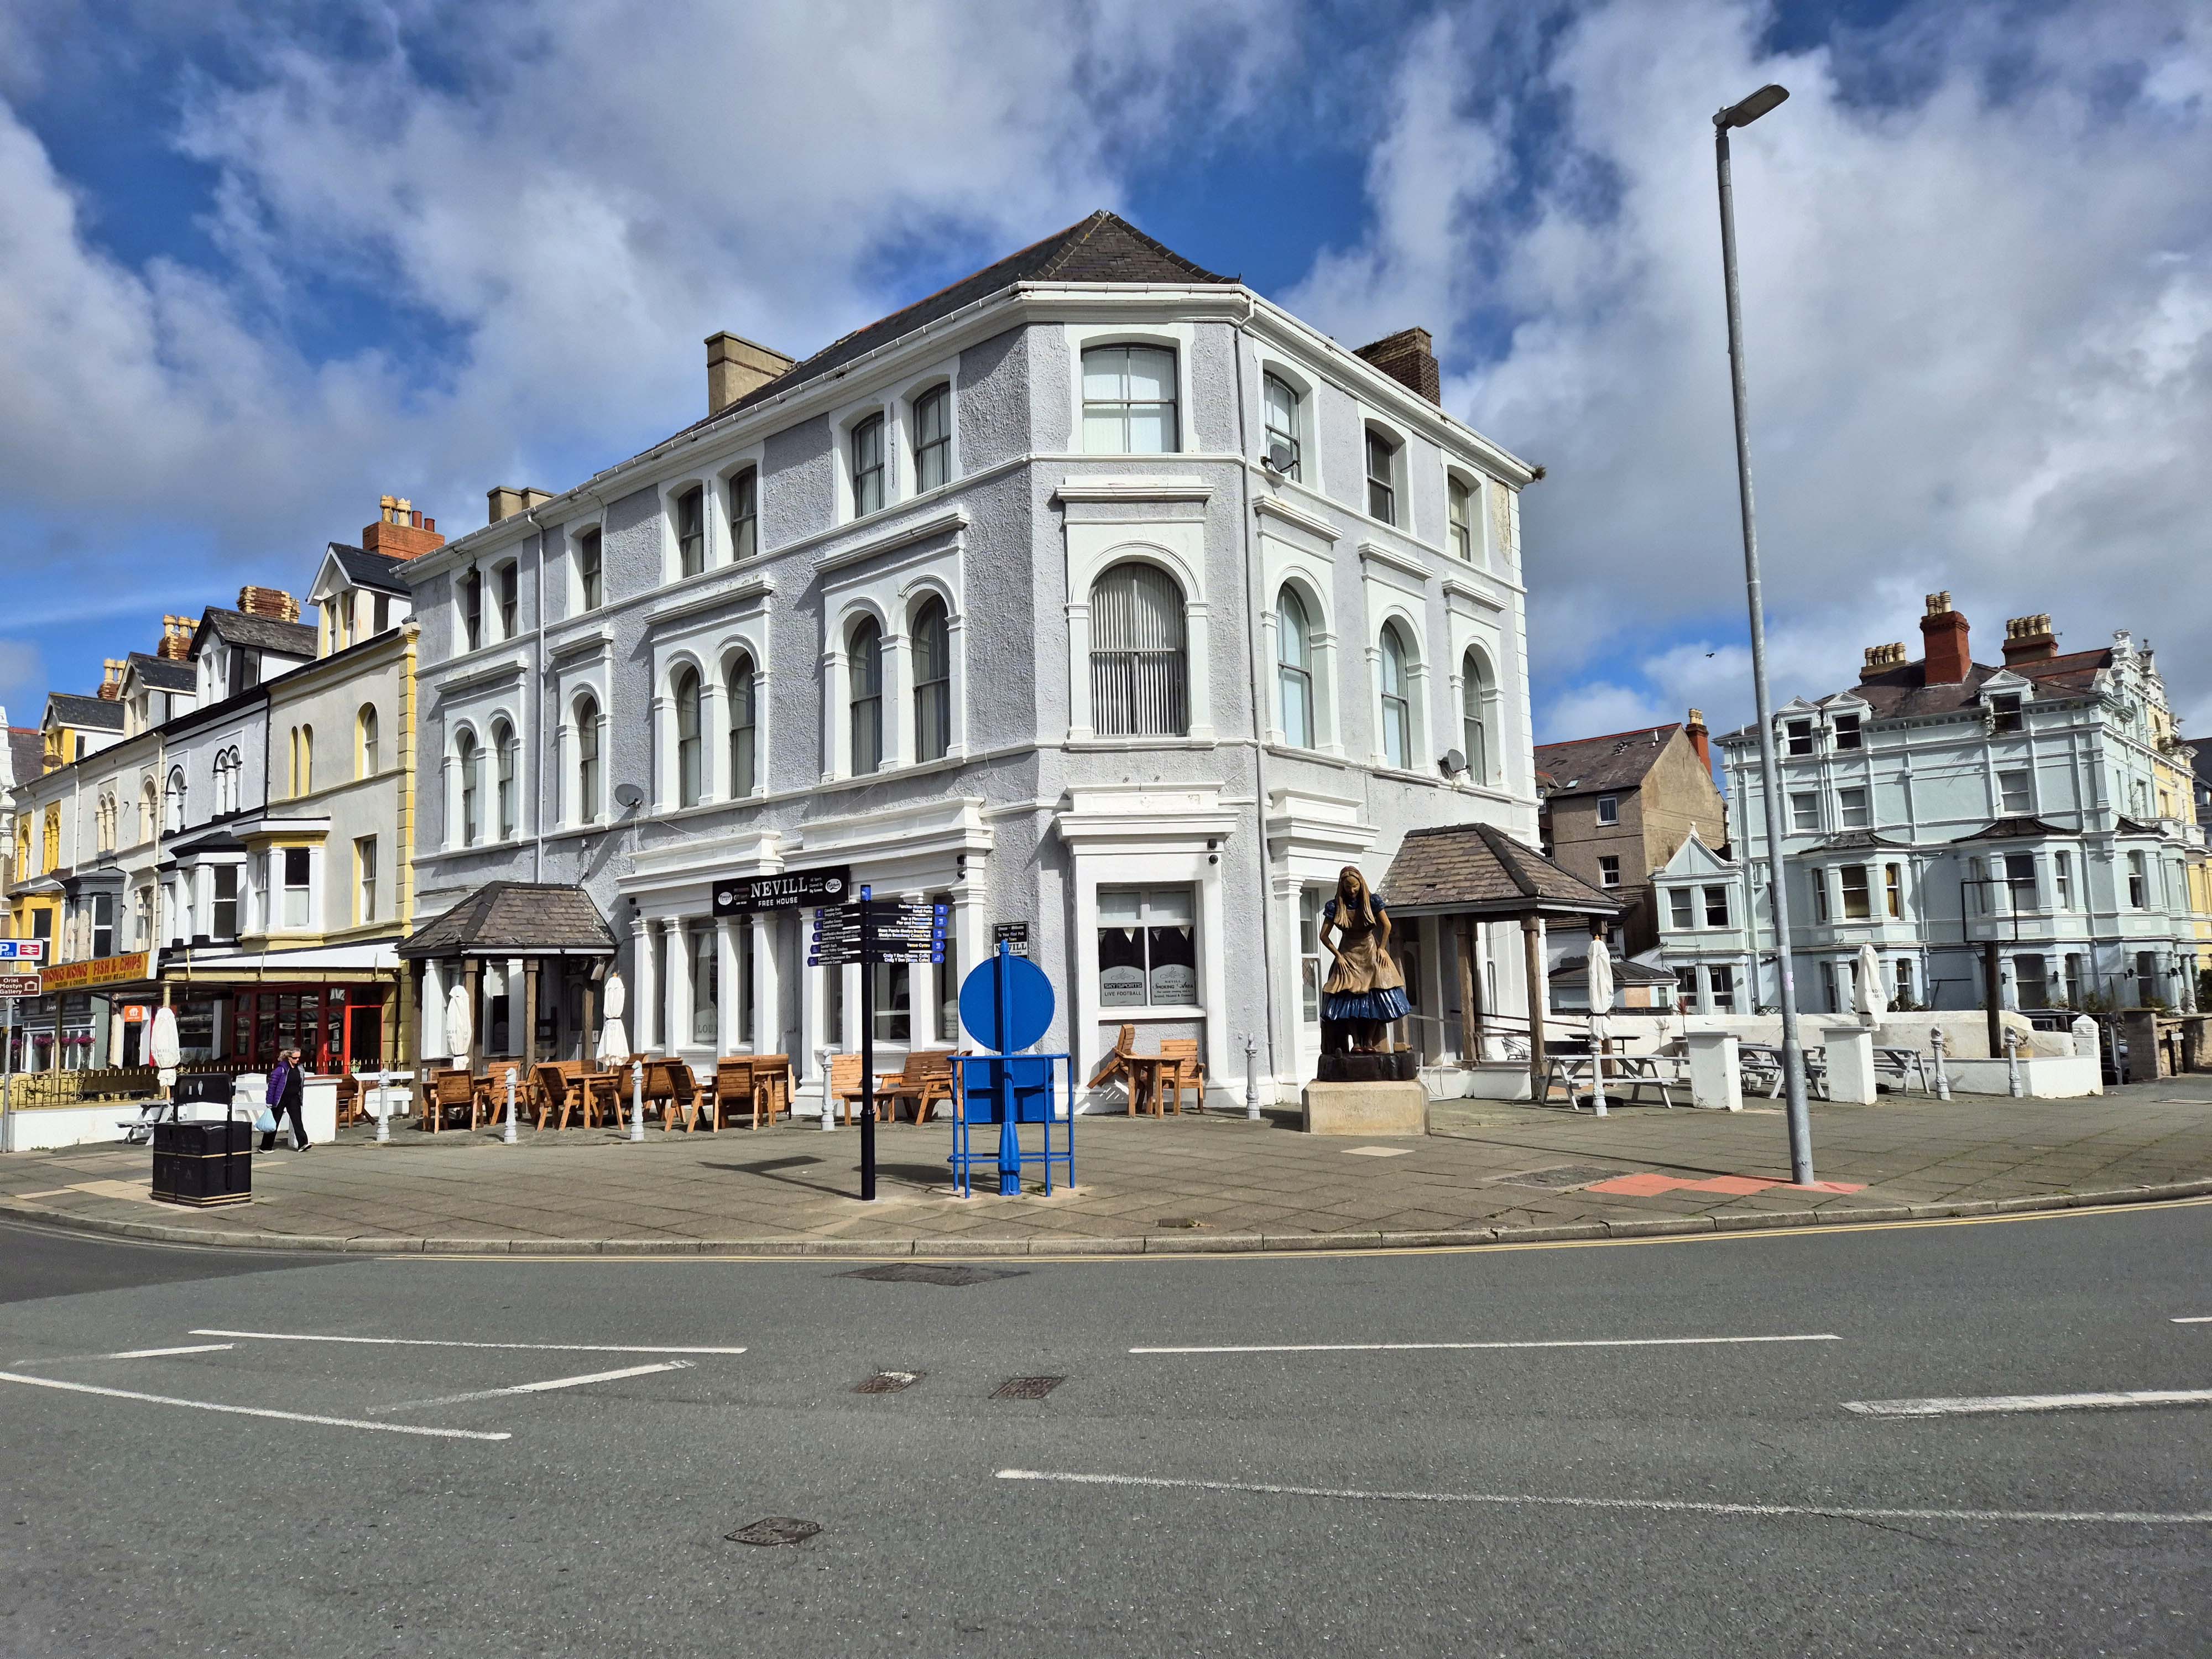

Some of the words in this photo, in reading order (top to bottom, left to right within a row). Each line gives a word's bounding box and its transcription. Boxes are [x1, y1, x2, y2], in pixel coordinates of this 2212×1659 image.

[750, 877, 808, 898] NEVILL
[776, 896, 798, 905] HOUSE
[0, 943, 9, 956] P
[42, 968, 64, 983] HONG
[66, 963, 88, 979] KONG
[93, 959, 109, 976] FISH
[111, 958, 117, 972] &
[119, 954, 142, 971] CHIPS
